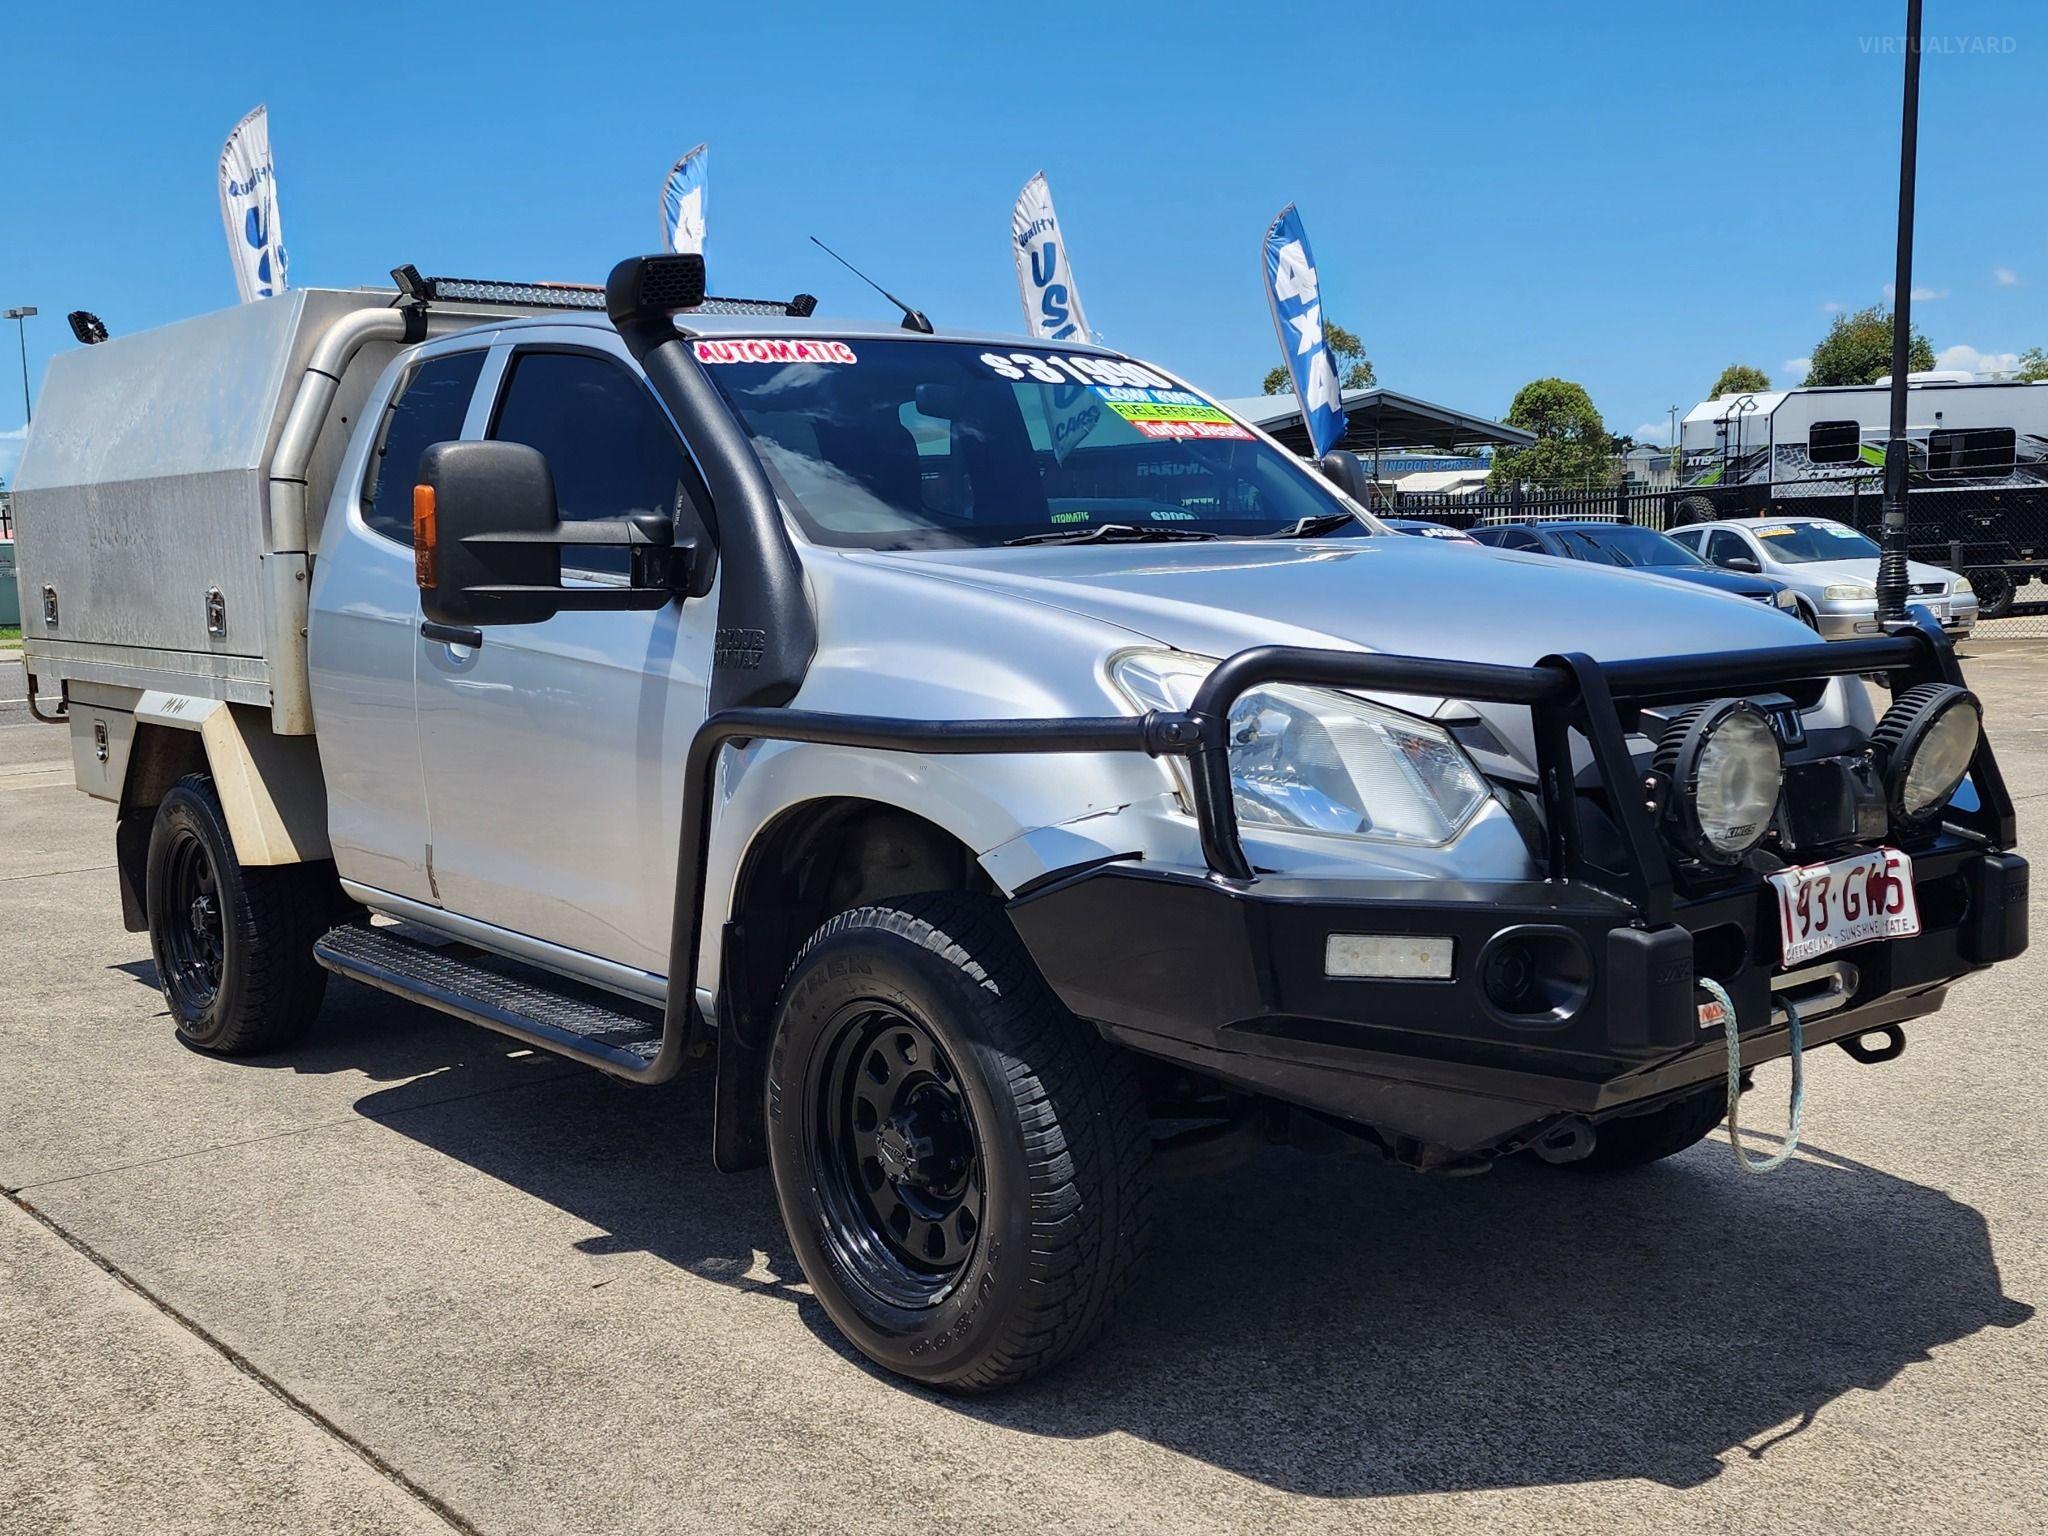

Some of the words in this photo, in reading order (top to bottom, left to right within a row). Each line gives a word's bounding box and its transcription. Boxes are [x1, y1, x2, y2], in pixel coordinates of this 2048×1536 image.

[695, 340, 857, 364] AUTOMATIC
[980, 352, 1173, 389] $31990
[1095, 387, 1152, 402] LOW
[1113, 404, 1155, 417] FUEL
[1154, 405, 1224, 419] EFFICIENT
[1134, 420, 1196, 437] Turbo
[1187, 422, 1249, 439] Diesel
[1384, 461, 1429, 472] INDOOR
[1432, 460, 1473, 470] SPORTS
[1840, 920, 1879, 942] SUNSHINE
